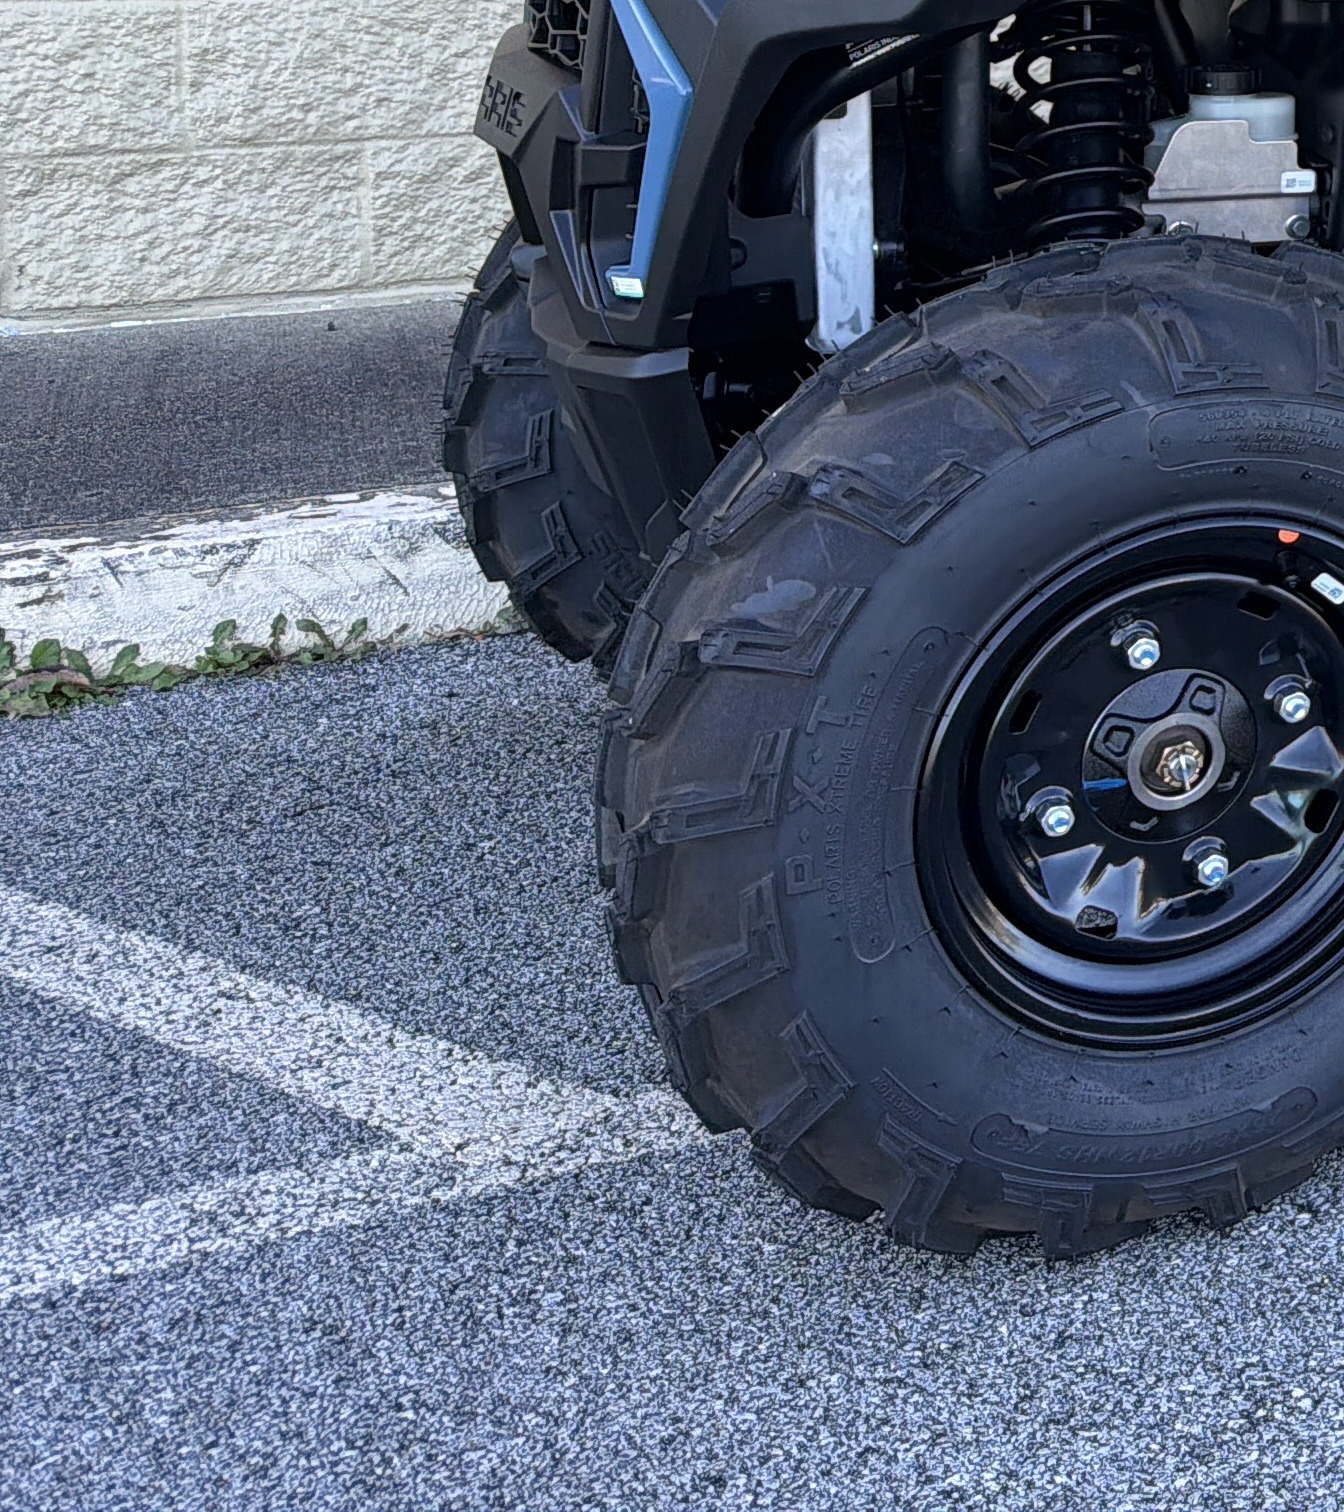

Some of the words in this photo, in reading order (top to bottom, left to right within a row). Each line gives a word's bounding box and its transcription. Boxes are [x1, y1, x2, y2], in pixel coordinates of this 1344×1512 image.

[850, 685, 878, 729] TIRE
[826, 738, 859, 815] XTREME
[826, 824, 845, 905] POLARIS
